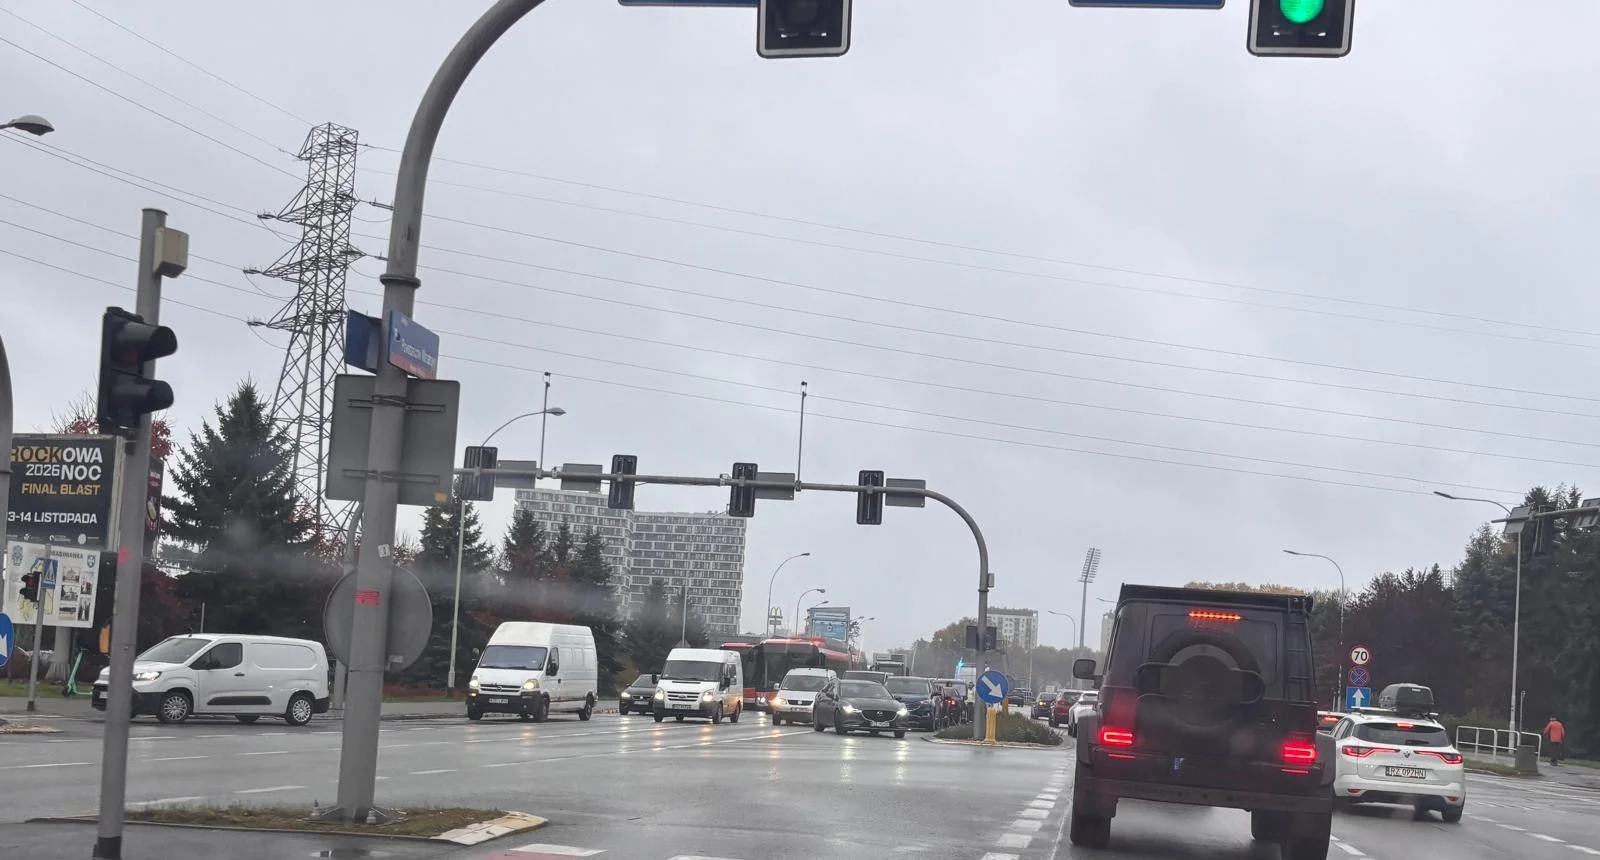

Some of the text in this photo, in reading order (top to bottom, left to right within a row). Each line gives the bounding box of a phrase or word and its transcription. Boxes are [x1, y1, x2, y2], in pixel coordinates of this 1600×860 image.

[26, 464, 102, 481] 2026 NOC
[22, 483, 101, 496] FINAL BLAST
[34, 512, 98, 524] LISTOPADA
[1353, 650, 1368, 661] 70
